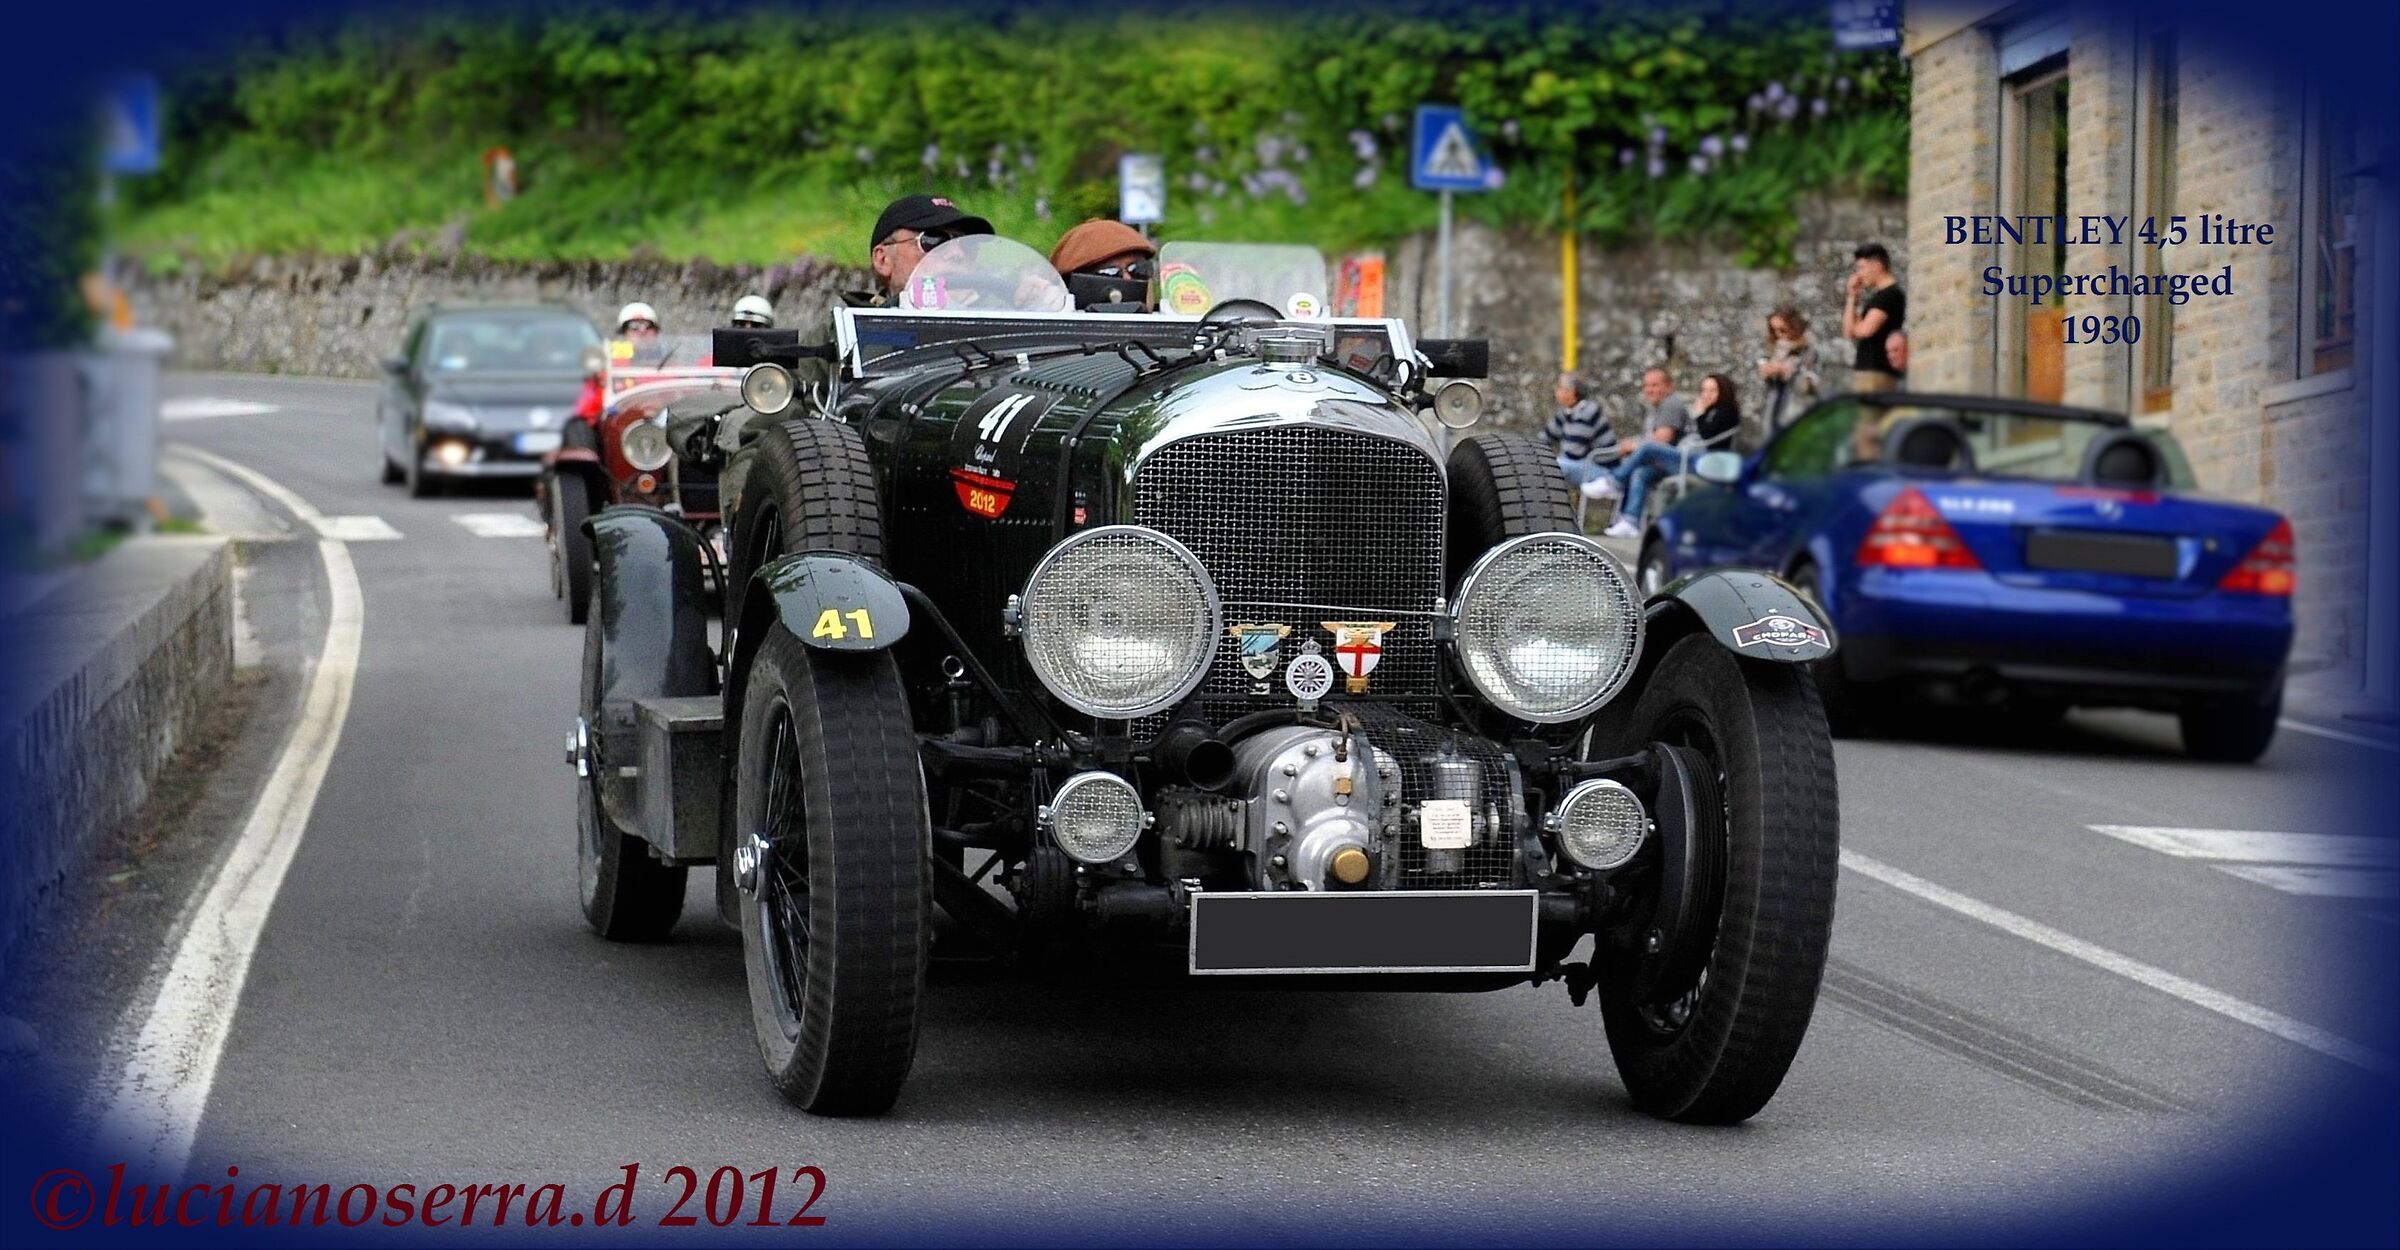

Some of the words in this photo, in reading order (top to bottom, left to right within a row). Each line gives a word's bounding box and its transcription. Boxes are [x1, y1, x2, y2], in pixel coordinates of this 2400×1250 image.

[978, 393, 1036, 443] 41
[970, 489, 996, 513] 2012
[812, 608, 874, 640] 41
